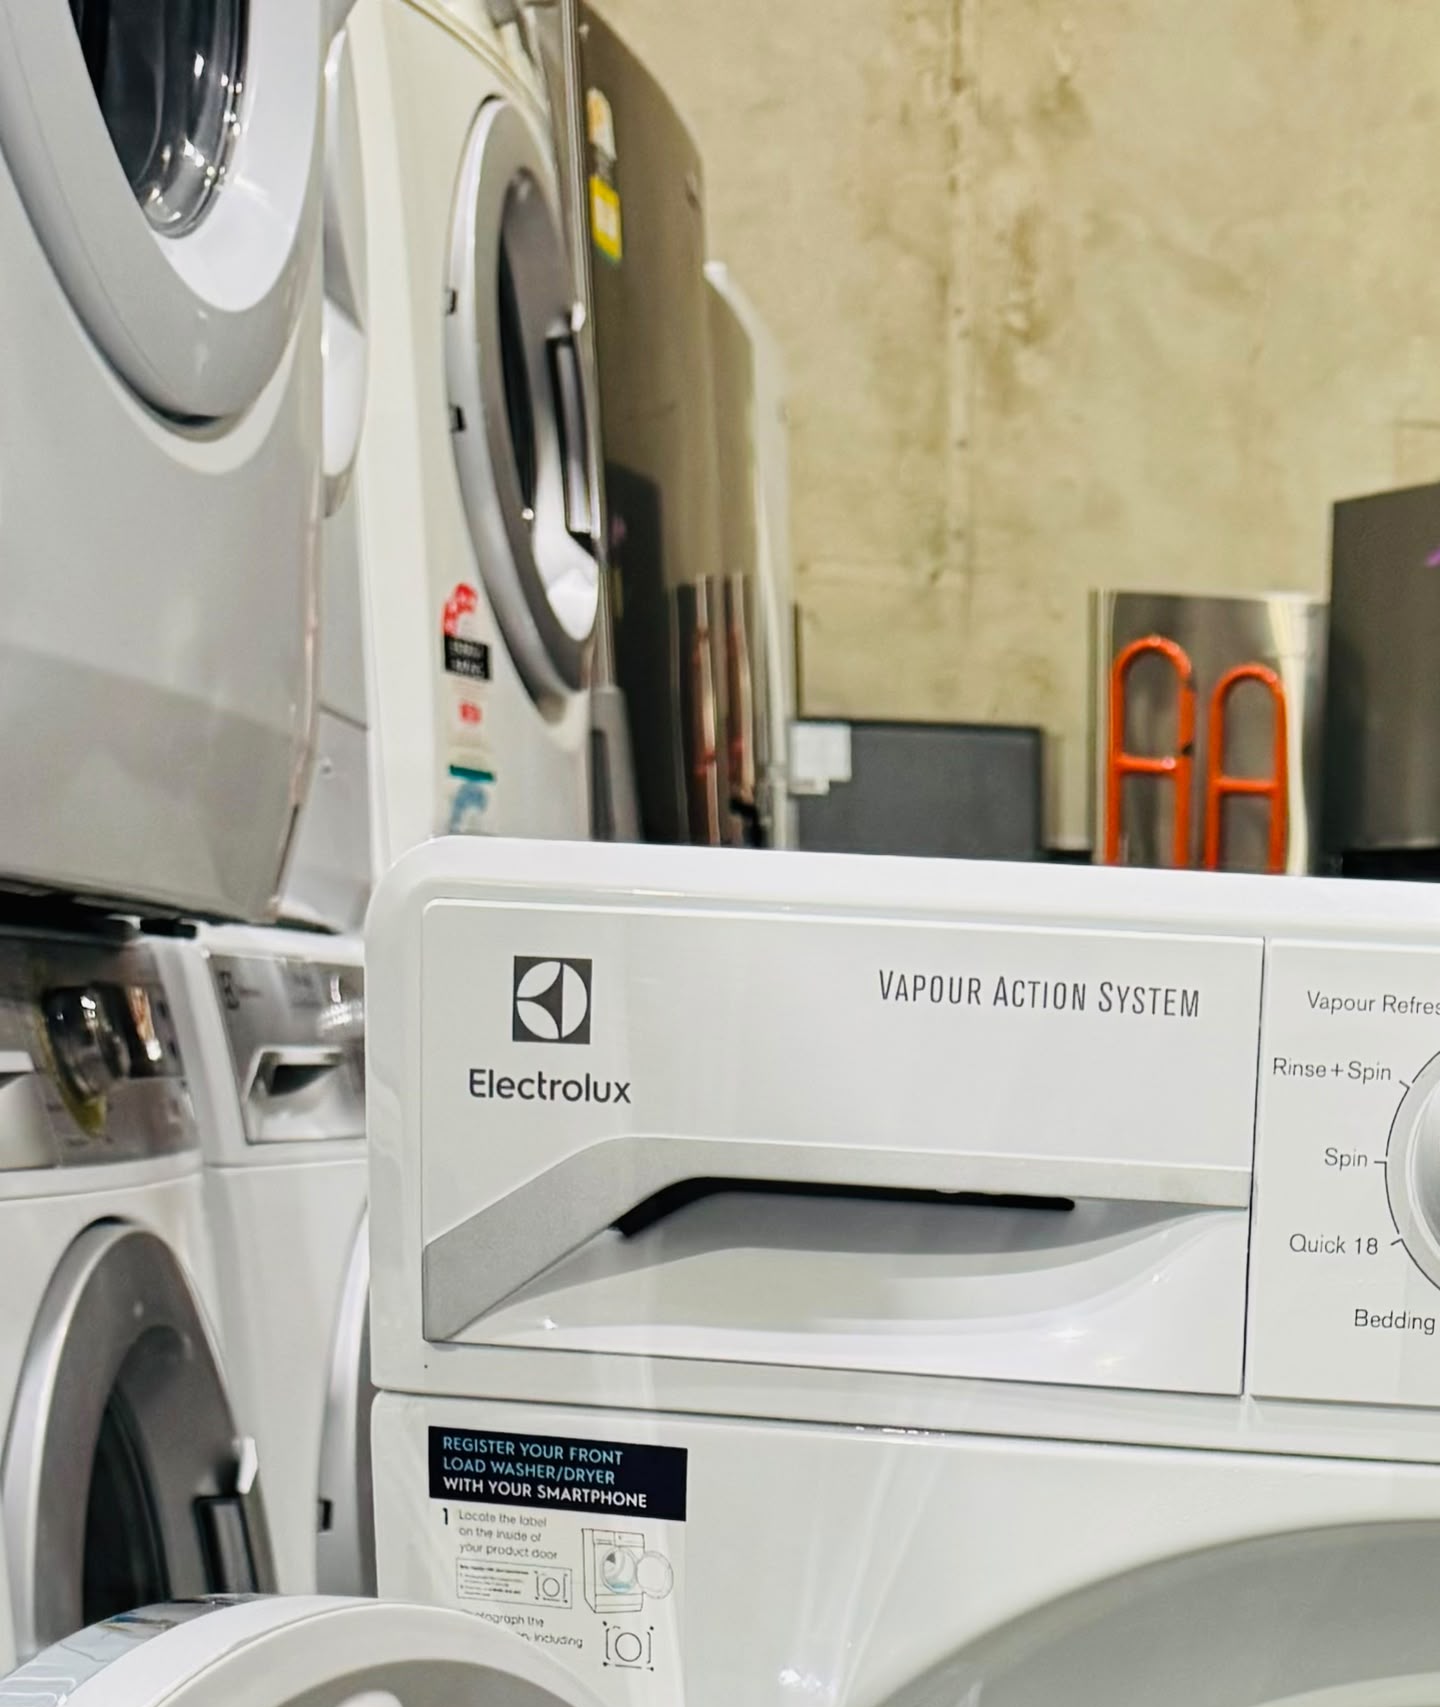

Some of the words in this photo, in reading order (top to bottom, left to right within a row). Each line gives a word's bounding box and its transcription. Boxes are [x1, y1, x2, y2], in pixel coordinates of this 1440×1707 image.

[879, 969, 983, 1007] VAPOUR
[993, 975, 1087, 1012] ACTION
[1096, 981, 1201, 1019] SYSTEM
[1307, 990, 1376, 1016] Vapour
[468, 1068, 632, 1106] Electrolux
[1324, 1148, 1368, 1171] Spin
[1289, 1234, 1346, 1256] Quick
[1354, 1236, 1379, 1256] 18
[1354, 1309, 1436, 1336] Bedding
[443, 1436, 515, 1456] REGISTER
[520, 1442, 564, 1460] YOUR
[569, 1447, 623, 1465] FRONT
[443, 1457, 486, 1473] LOAD
[490, 1460, 615, 1485] WASHER/DRYER
[443, 1477, 484, 1493] WITH
[488, 1481, 532, 1498] YOUR
[537, 1485, 647, 1508] SMARTPHONE
[443, 1508, 448, 1525] 1
[459, 1510, 496, 1523] Locate
[500, 1511, 516, 1524] the
[520, 1514, 547, 1527] label
[459, 1527, 473, 1536] on
[476, 1527, 492, 1538] the
[530, 1532, 541, 1542] of
[460, 1543, 482, 1554] your
[486, 1544, 528, 1557] product
[532, 1549, 557, 1559] door
